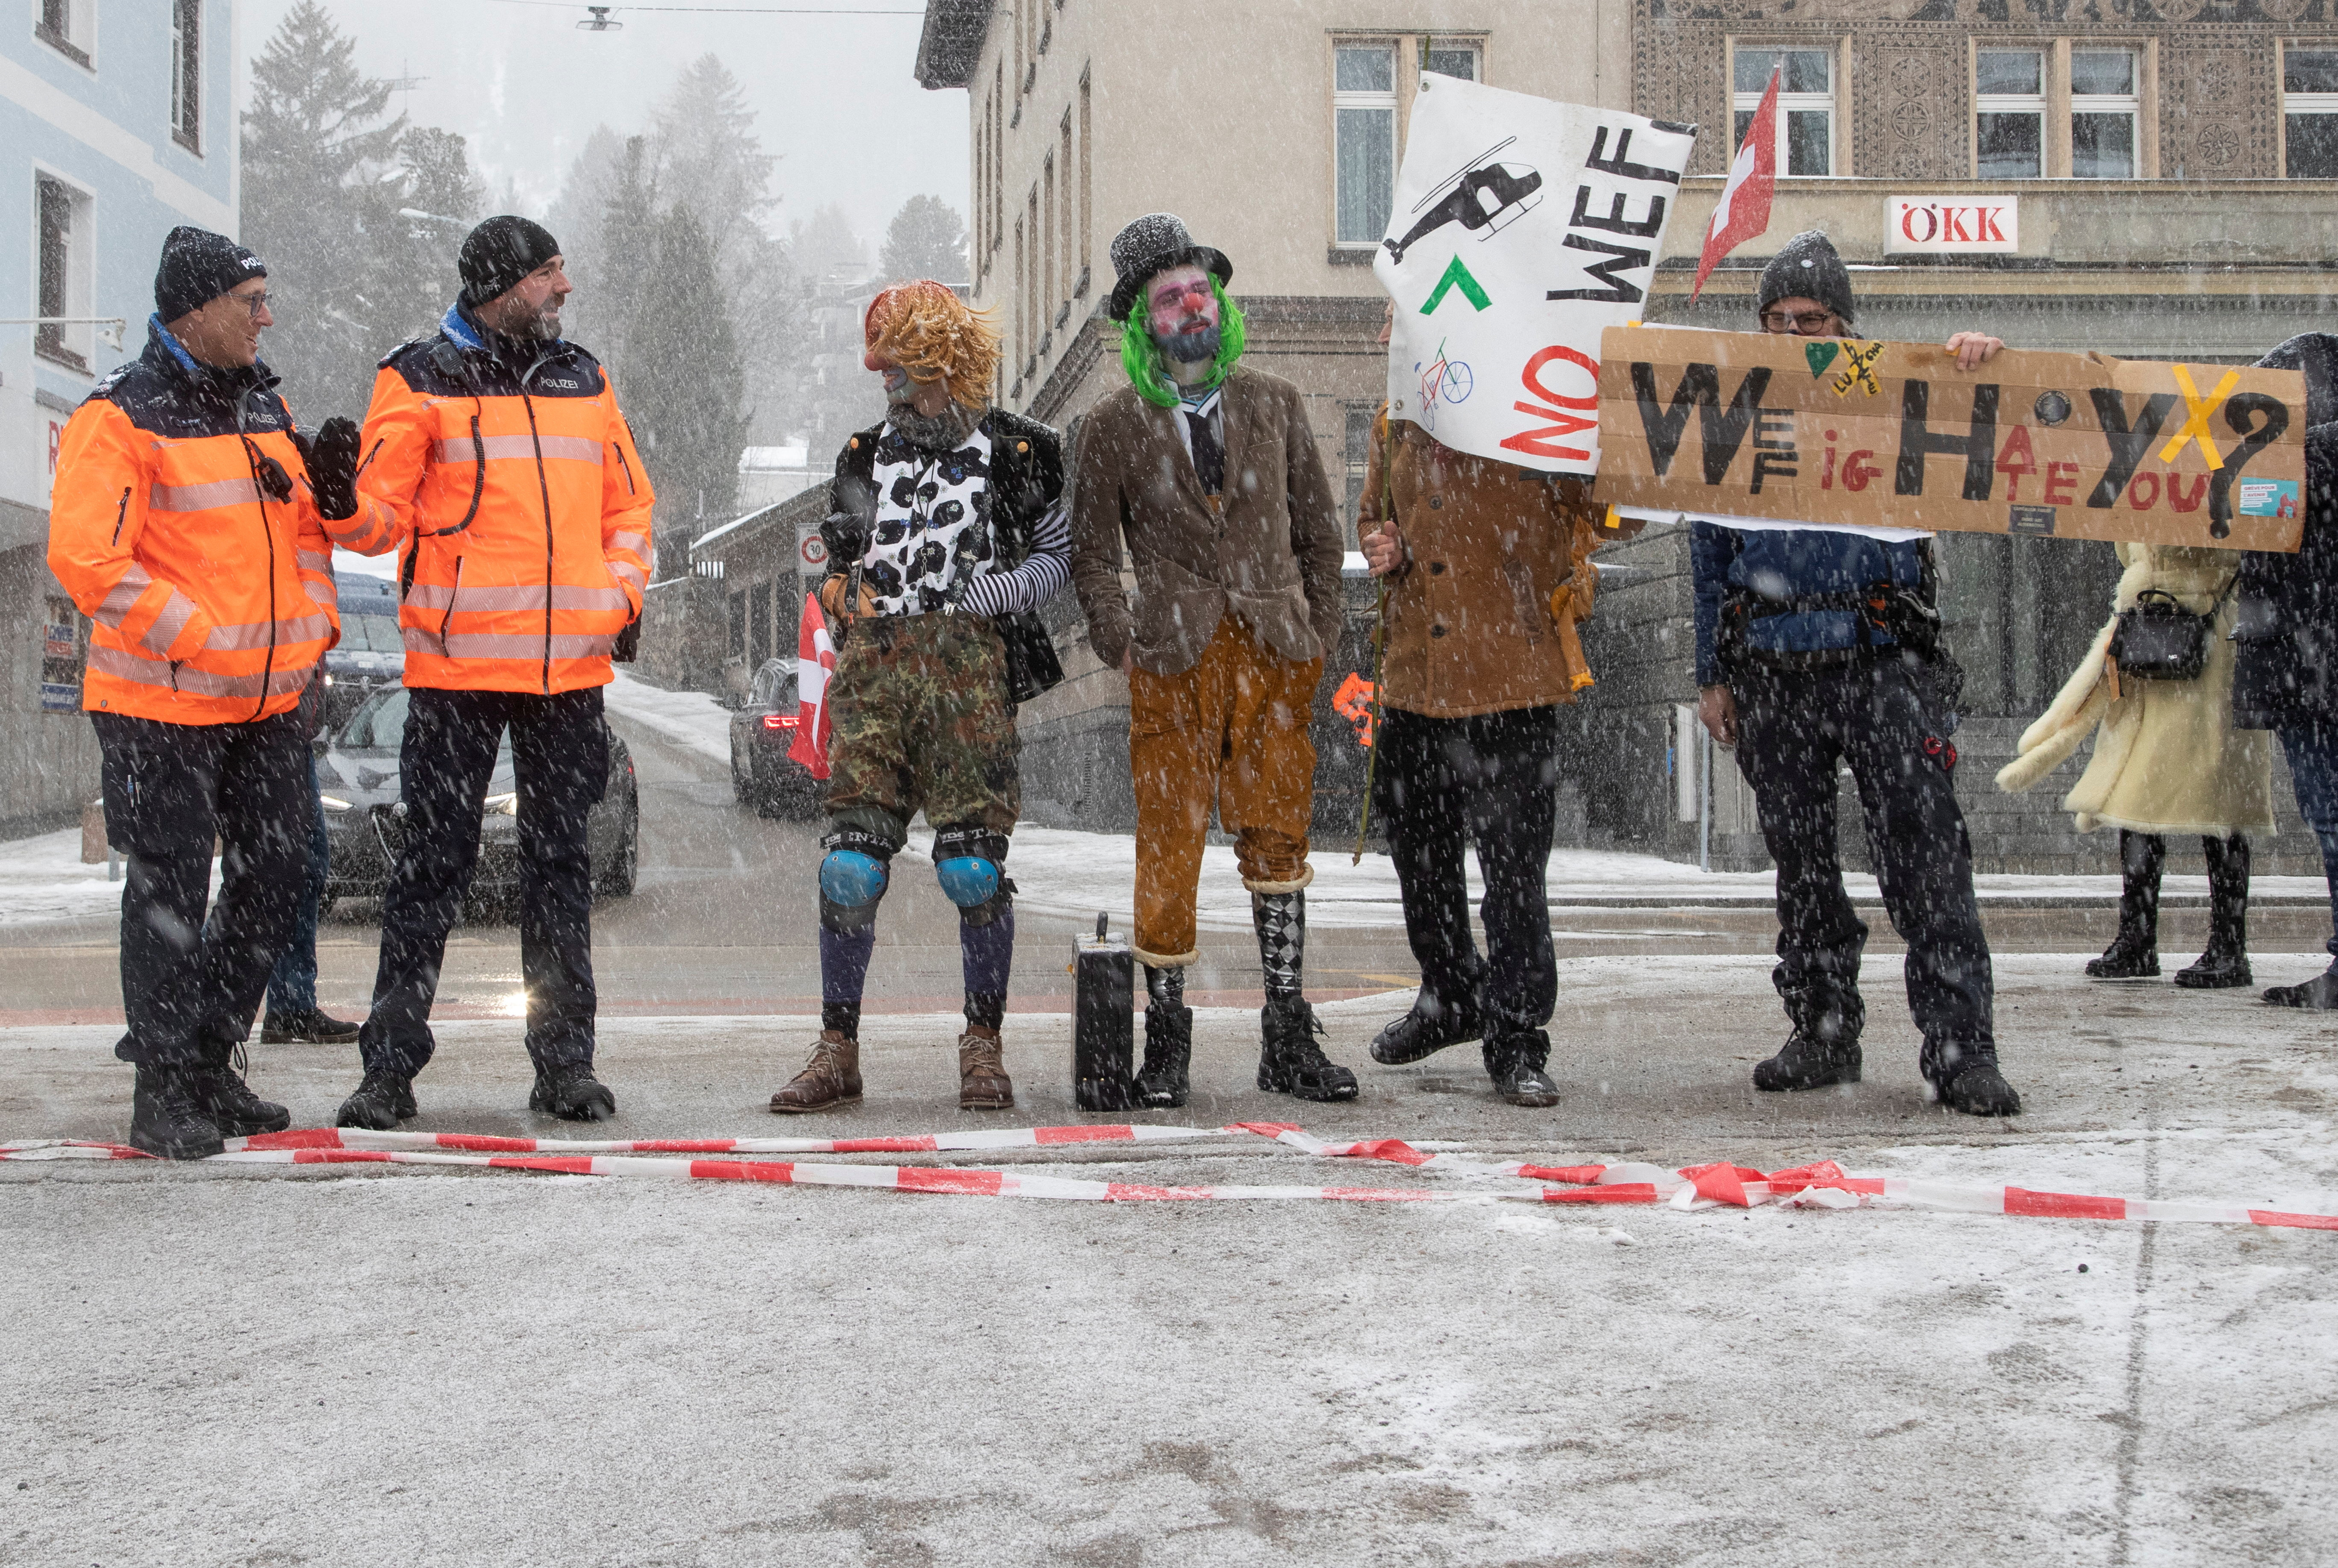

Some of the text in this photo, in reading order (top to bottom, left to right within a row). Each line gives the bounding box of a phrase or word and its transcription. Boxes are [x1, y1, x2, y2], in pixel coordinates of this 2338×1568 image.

[1546, 126, 1679, 303] WEF
[1902, 203, 2008, 242] ÖKK
[540, 376, 579, 389] POLIZEI
[1500, 345, 1599, 461] NO
[247, 412, 278, 424] POLIZEI
[810, 545, 821, 555] 30
